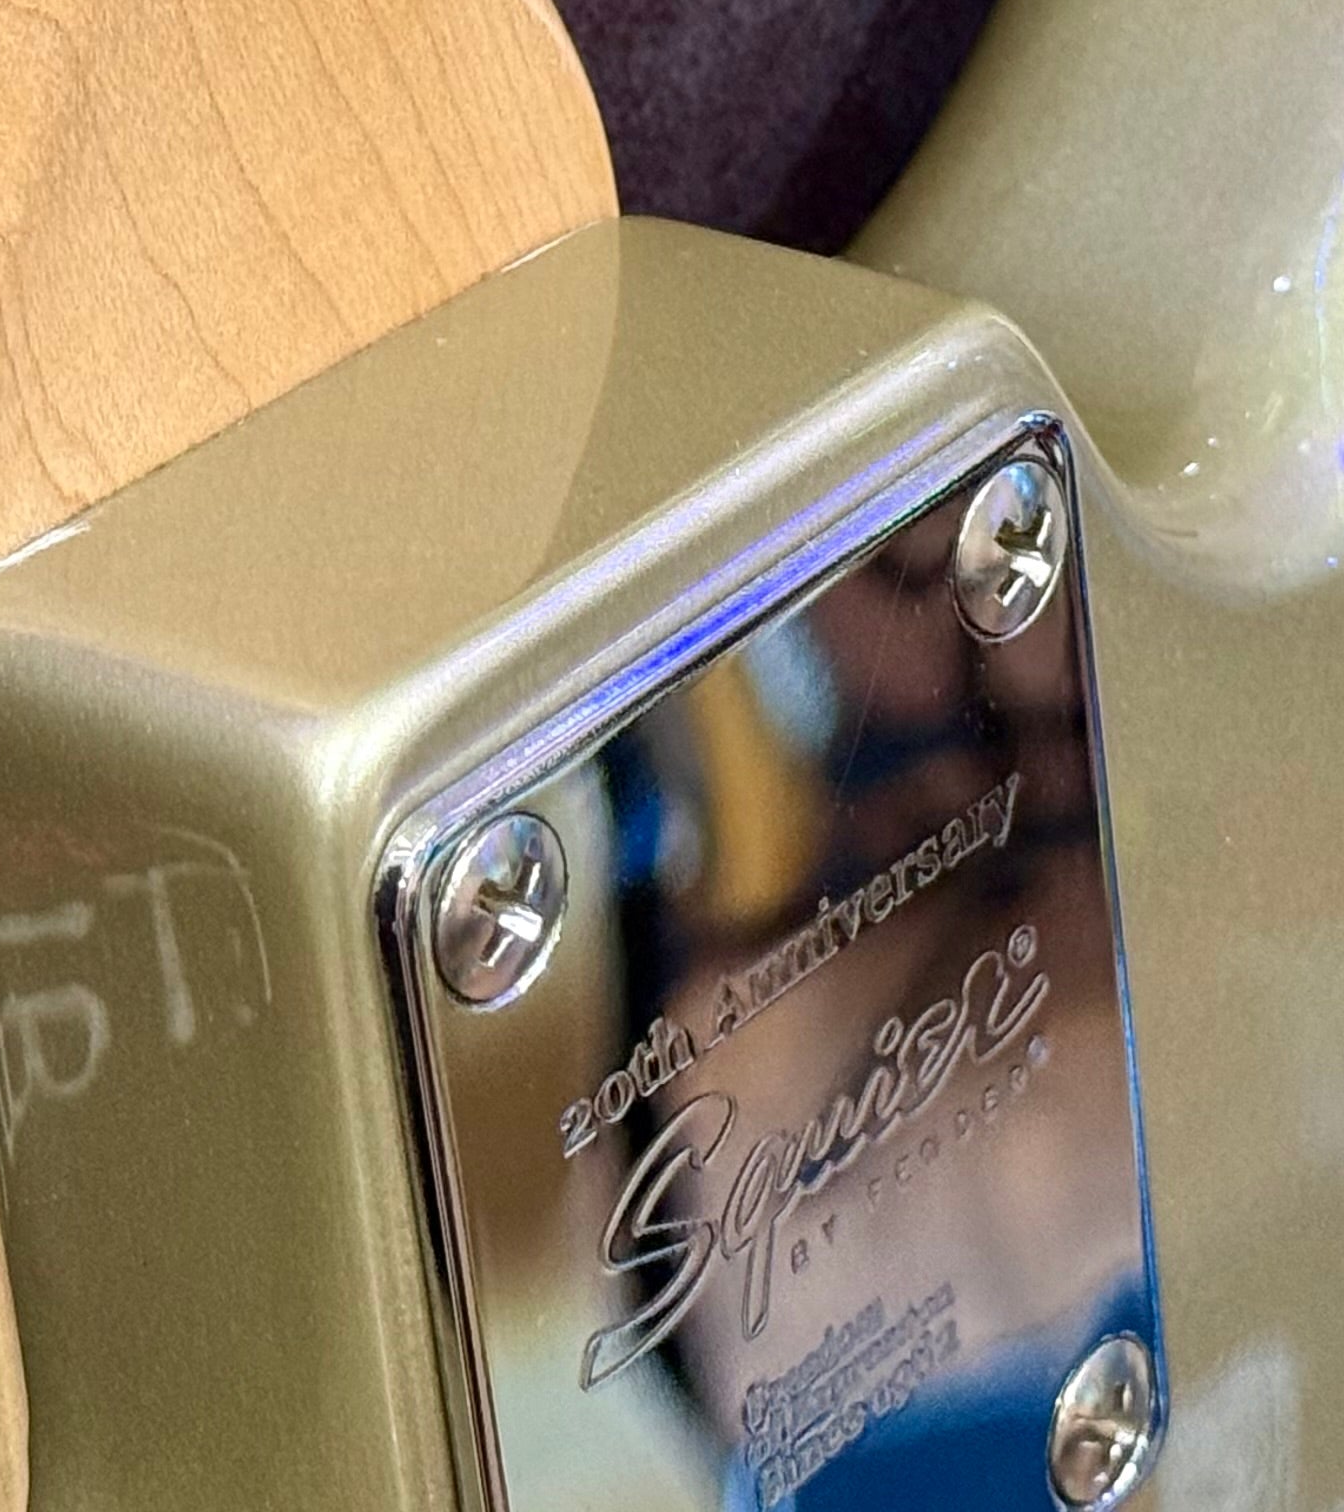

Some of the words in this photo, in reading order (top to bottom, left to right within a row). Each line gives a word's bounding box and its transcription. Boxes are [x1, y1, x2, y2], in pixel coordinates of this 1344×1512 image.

[557, 1008, 698, 1159] 20th
[706, 772, 1022, 1047] Anniversary
[789, 1213, 839, 1275] BY
